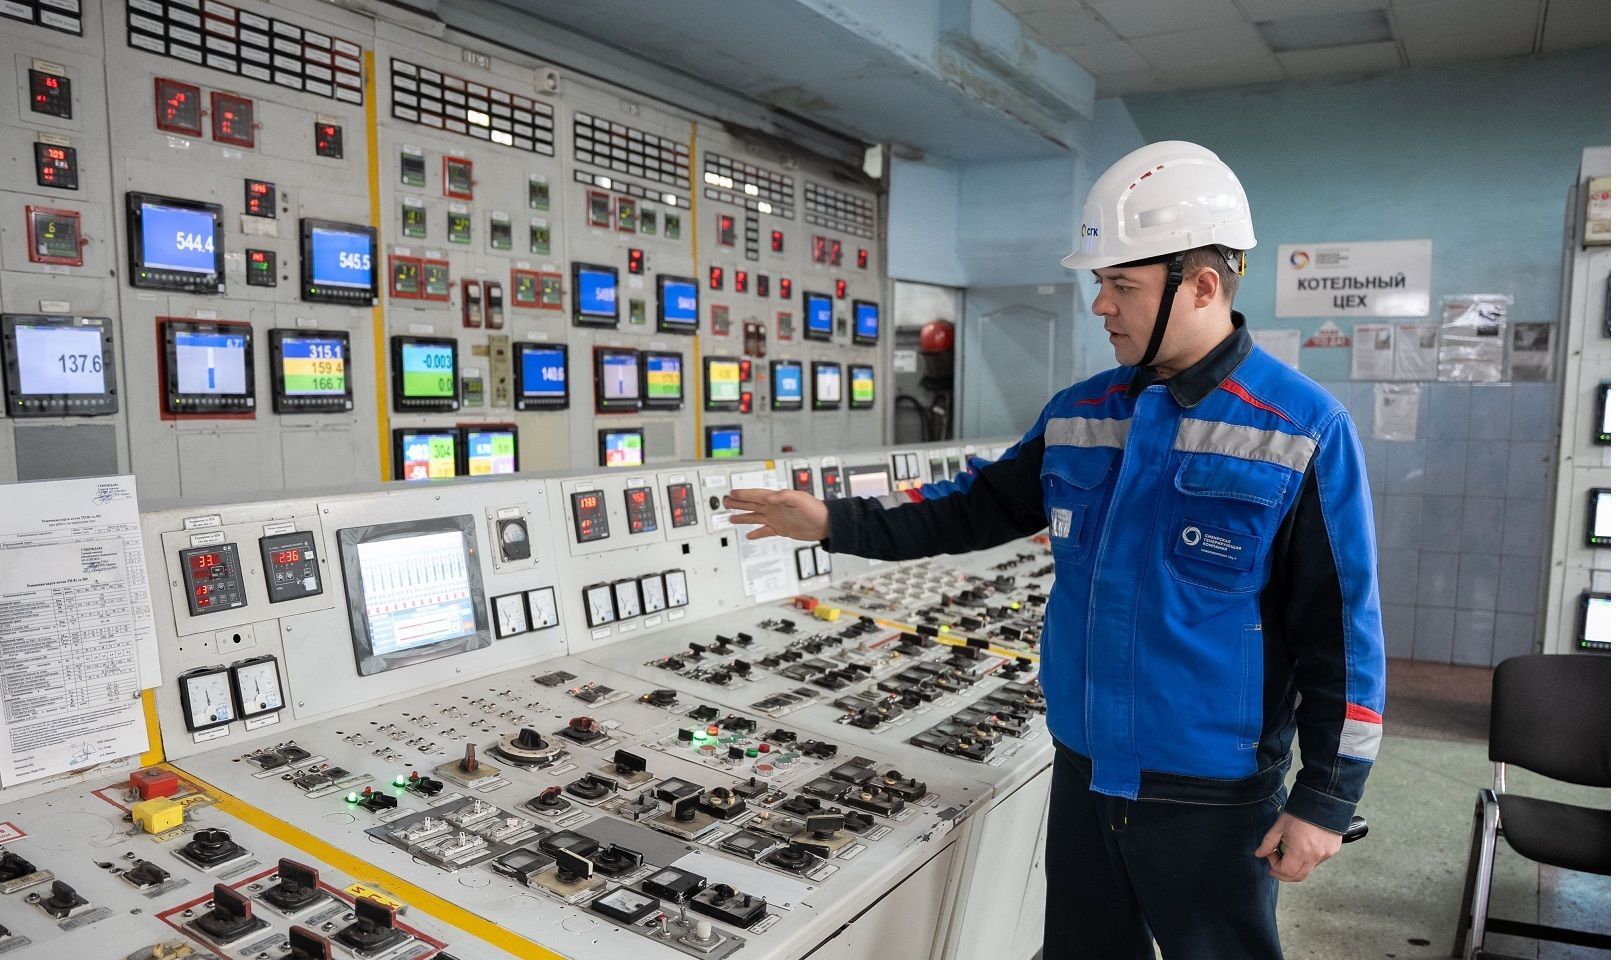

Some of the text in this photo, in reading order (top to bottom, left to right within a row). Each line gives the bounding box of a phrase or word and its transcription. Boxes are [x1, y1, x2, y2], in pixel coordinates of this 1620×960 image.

[176, 231, 215, 254] 544.4
[339, 251, 371, 271] 545.5
[1297, 272, 1406, 291] КОТЕЛЬНЫЙ
[1333, 295, 1368, 310] ЦЕХ
[309, 344, 341, 359] 315.1
[58, 354, 102, 374] 137.6
